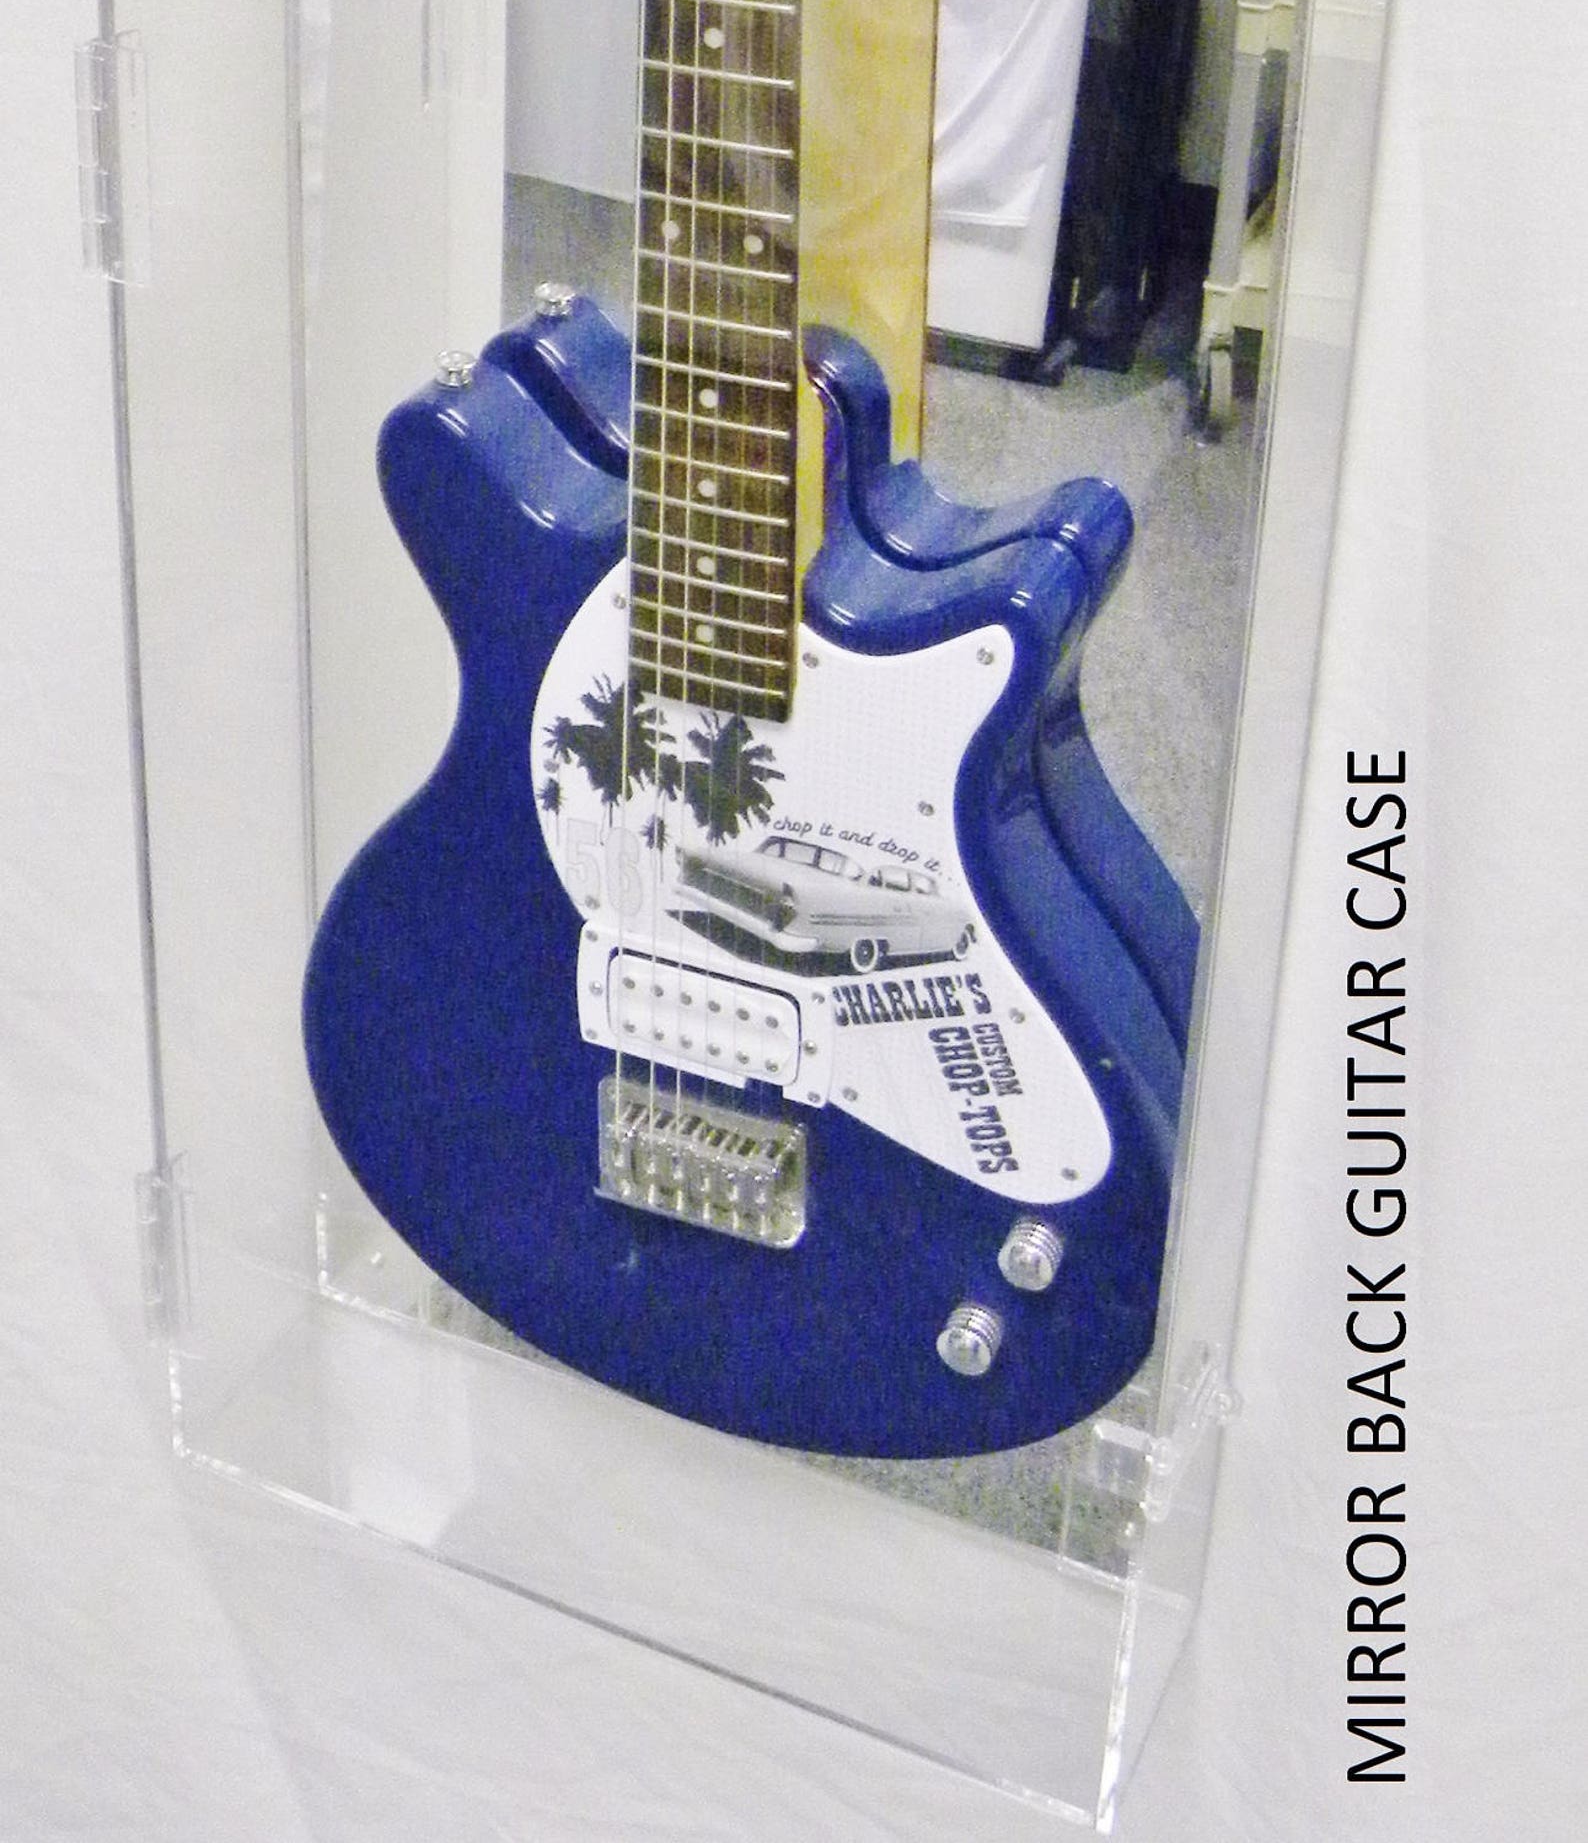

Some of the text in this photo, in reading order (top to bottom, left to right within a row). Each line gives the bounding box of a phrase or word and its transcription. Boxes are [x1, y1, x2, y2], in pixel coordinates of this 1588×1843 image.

[773, 815, 813, 837] chop
[819, 822, 834, 837] it
[838, 830, 876, 848] and
[878, 837, 920, 864] drop
[831, 973, 992, 1027] CHARLIE'S
[972, 1023, 1024, 1097] CUSTOM
[929, 1026, 1020, 1174] CHOP-TOPS
